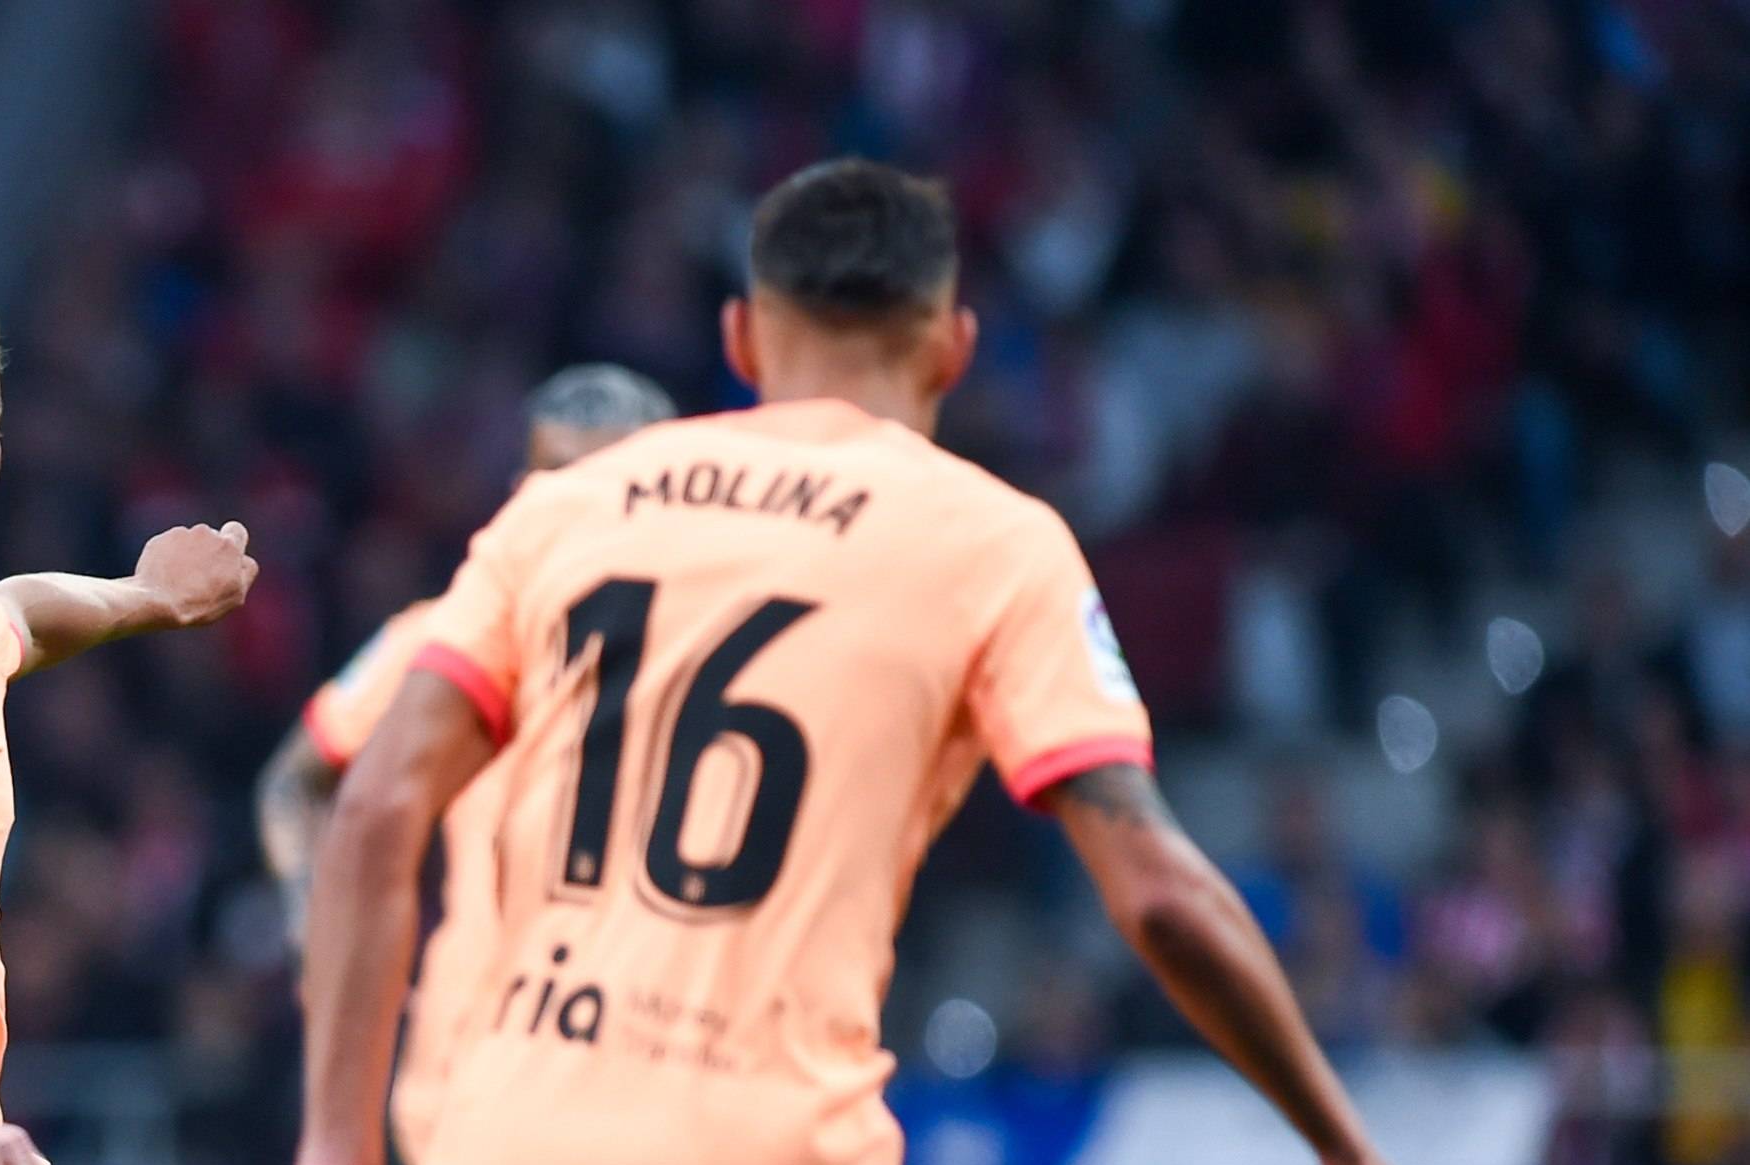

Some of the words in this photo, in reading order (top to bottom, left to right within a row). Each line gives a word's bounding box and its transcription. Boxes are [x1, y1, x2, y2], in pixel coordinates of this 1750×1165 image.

[623, 461, 869, 536] MOLINA
[553, 575, 821, 912] 16
[493, 944, 605, 1045] ria
